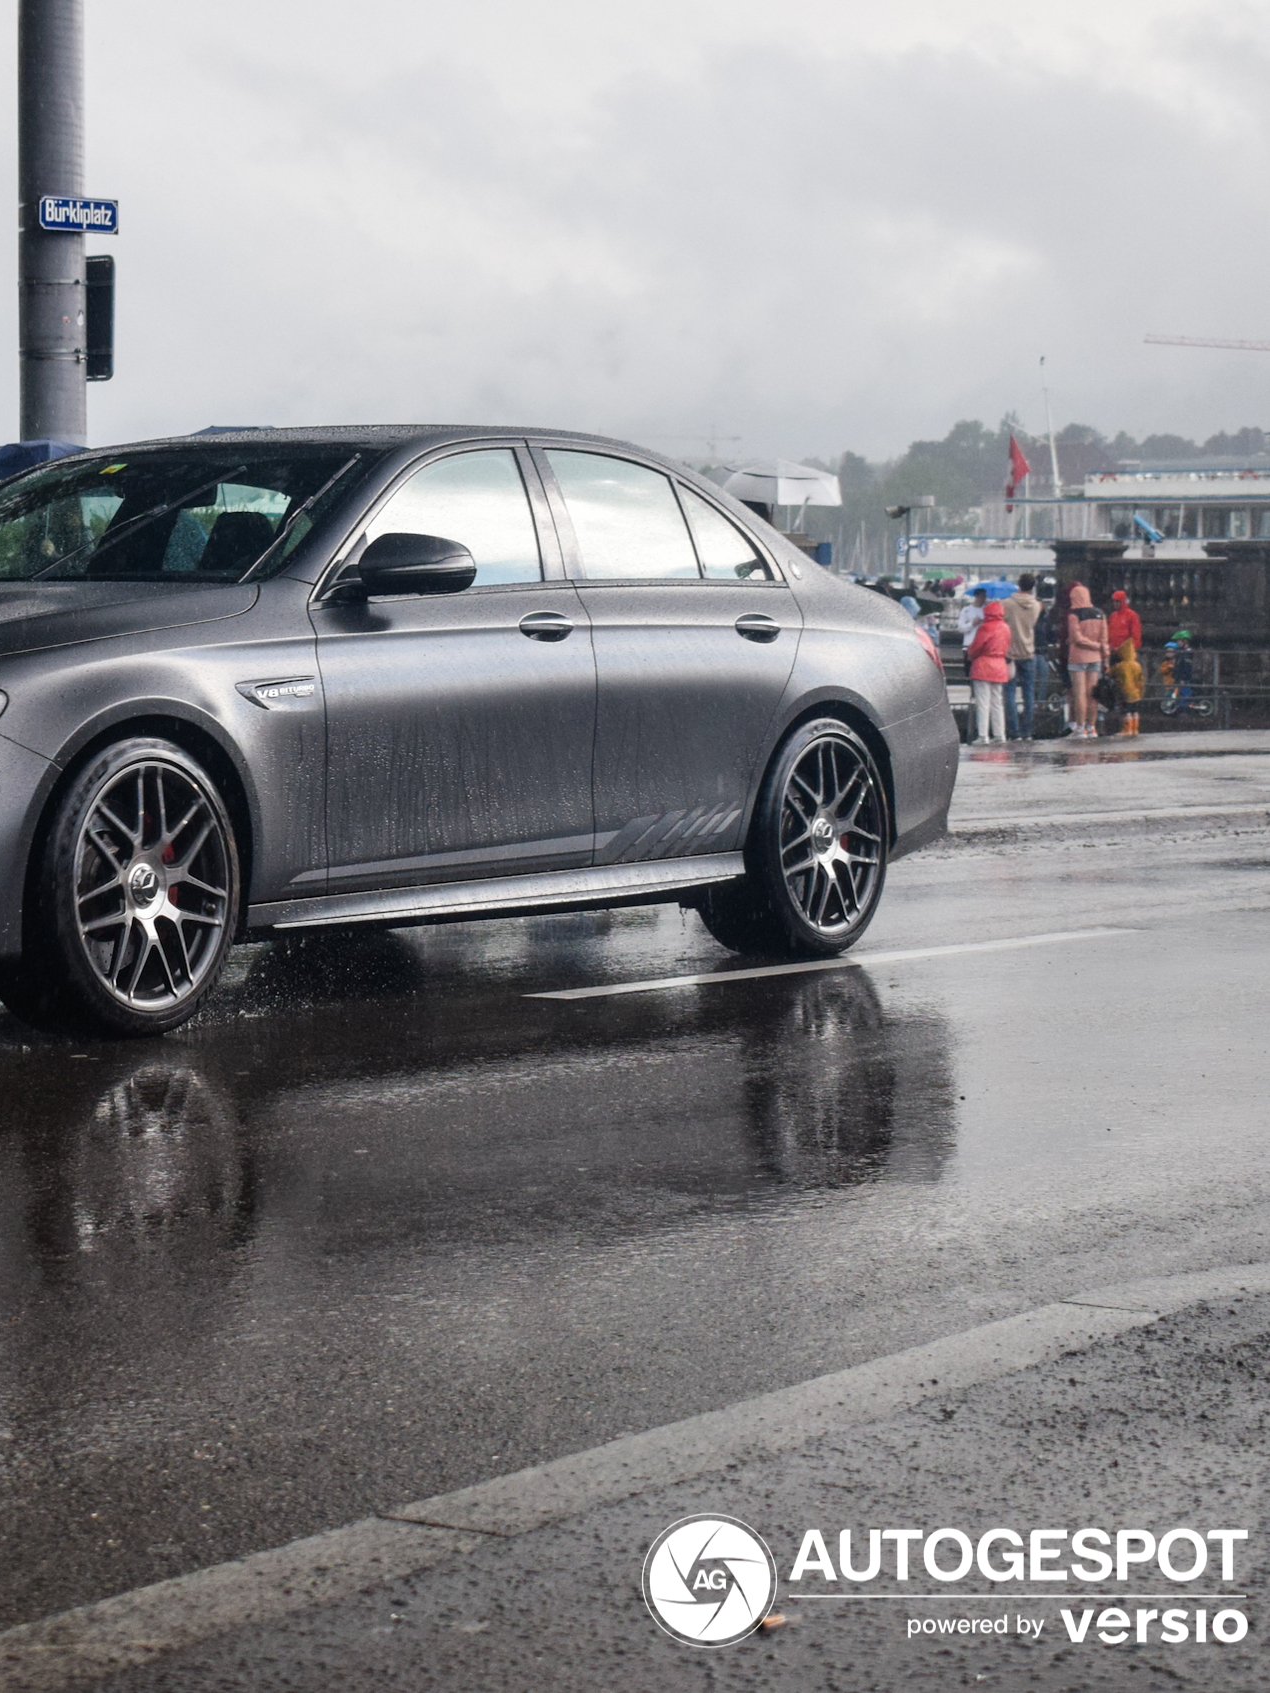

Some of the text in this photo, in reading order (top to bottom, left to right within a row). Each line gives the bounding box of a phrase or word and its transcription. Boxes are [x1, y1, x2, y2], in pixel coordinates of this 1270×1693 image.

[45, 199, 112, 229] Bürkliplatz
[257, 684, 315, 699] V8 BITURBO
